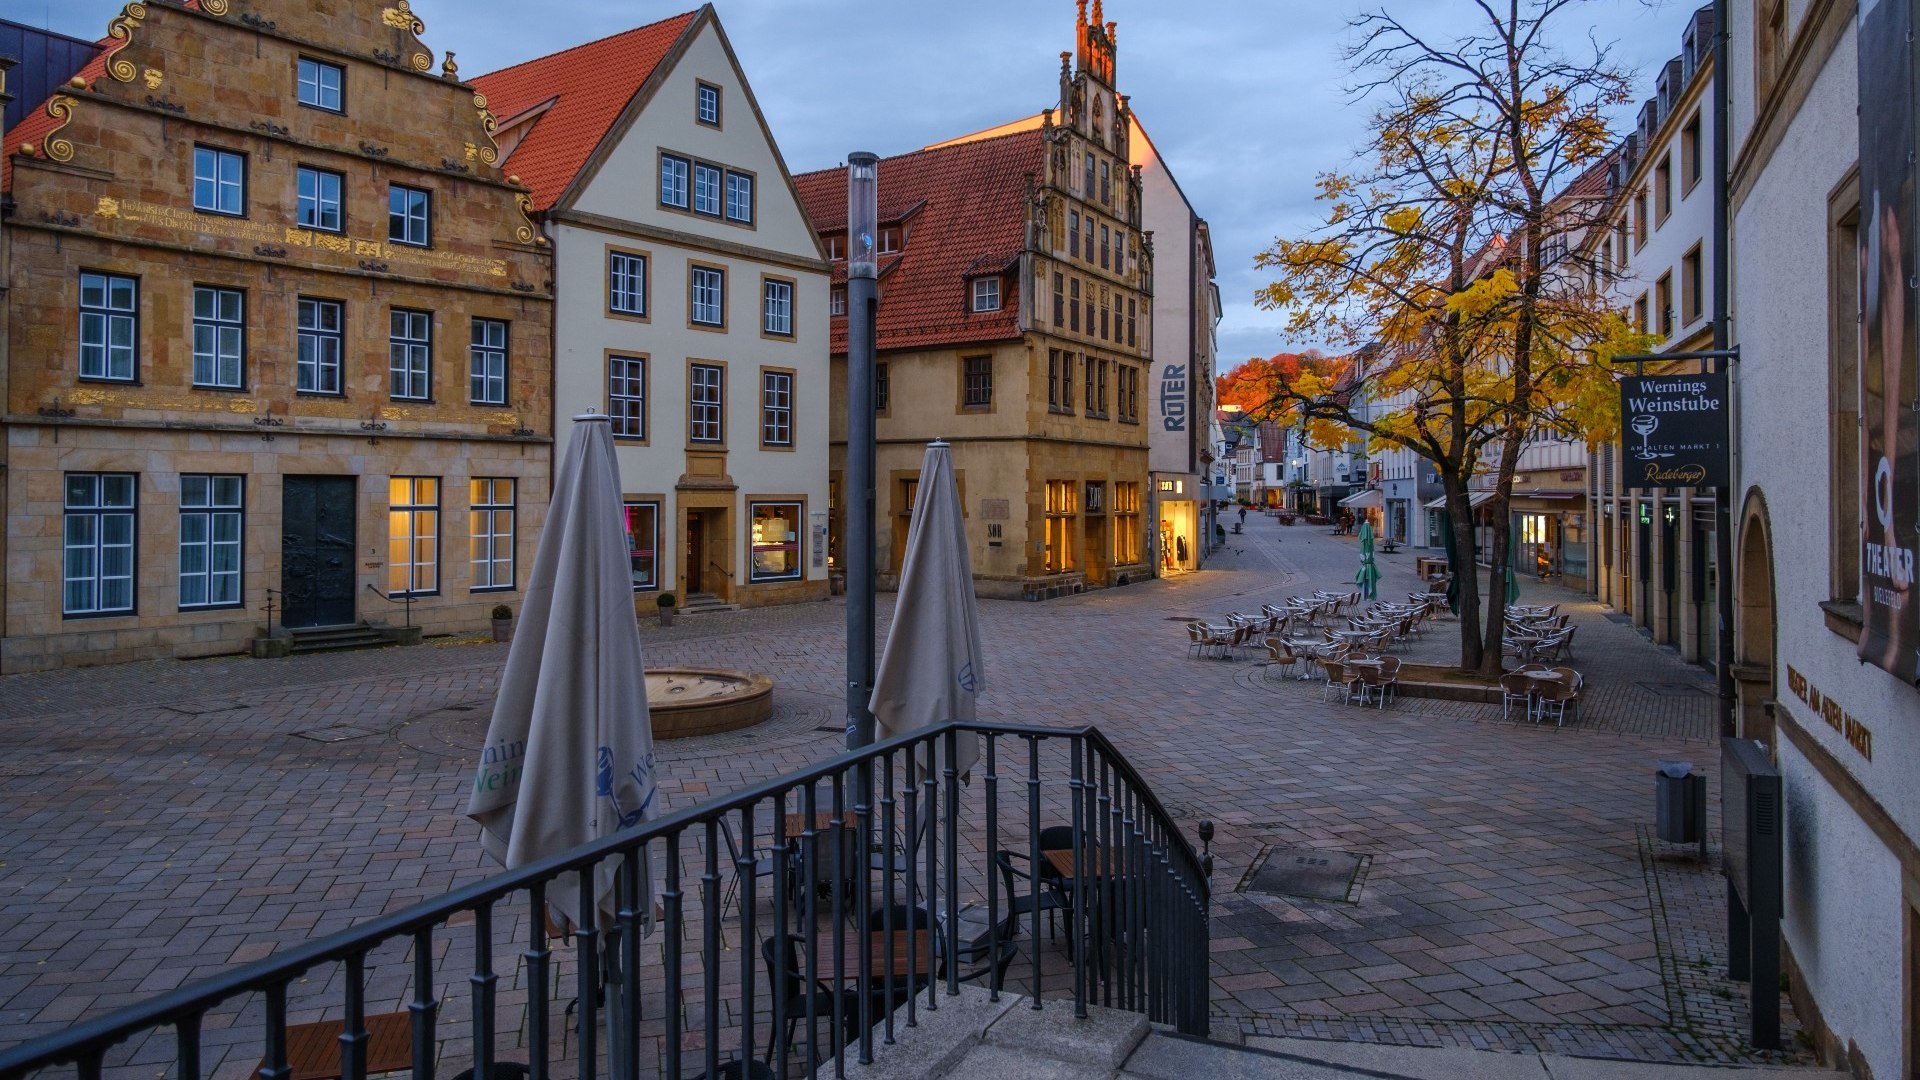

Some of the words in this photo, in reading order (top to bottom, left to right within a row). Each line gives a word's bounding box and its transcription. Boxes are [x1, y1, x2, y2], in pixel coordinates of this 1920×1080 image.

[1640, 380, 1707, 395] Wernings
[1629, 395, 1719, 412] Weinstube
[1644, 463, 1706, 485] Radeberger
[1866, 542, 1914, 584] THEATER
